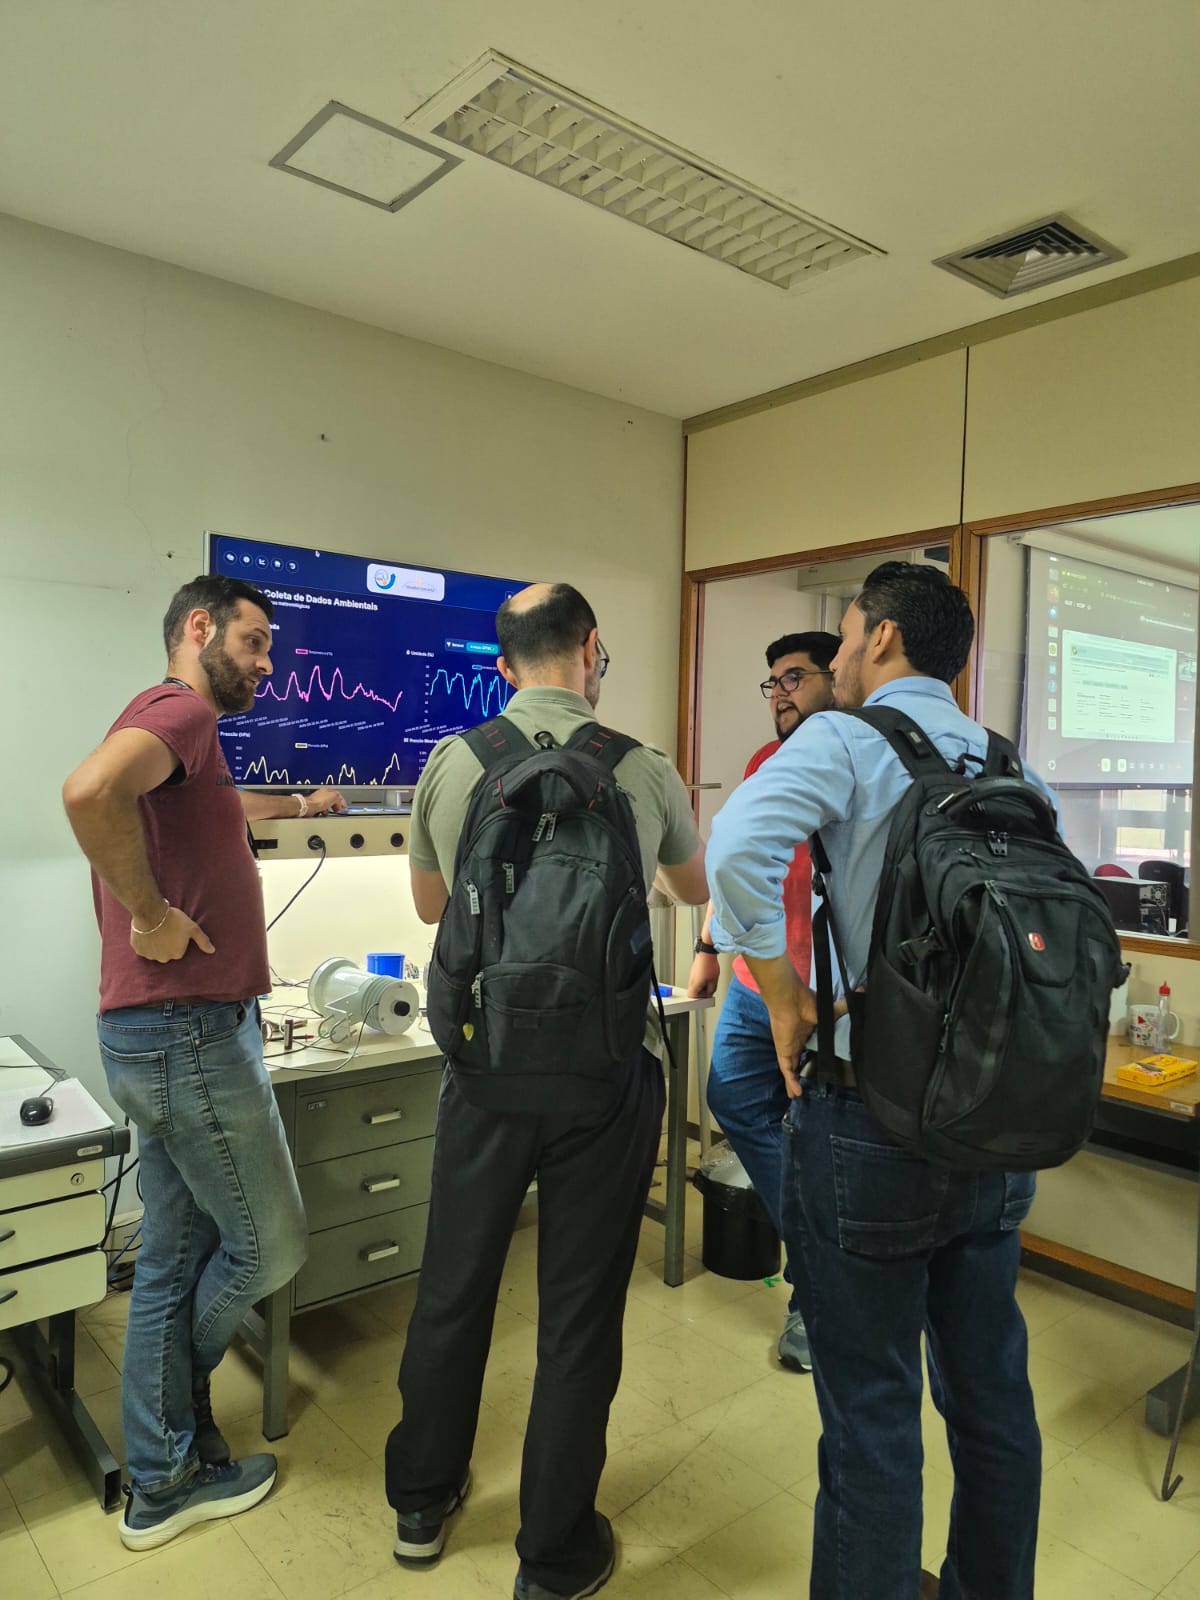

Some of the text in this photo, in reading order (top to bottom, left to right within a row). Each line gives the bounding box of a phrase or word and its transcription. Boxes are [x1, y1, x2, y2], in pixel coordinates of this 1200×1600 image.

[264, 589, 378, 610] Coleta de Dados Ambientais
